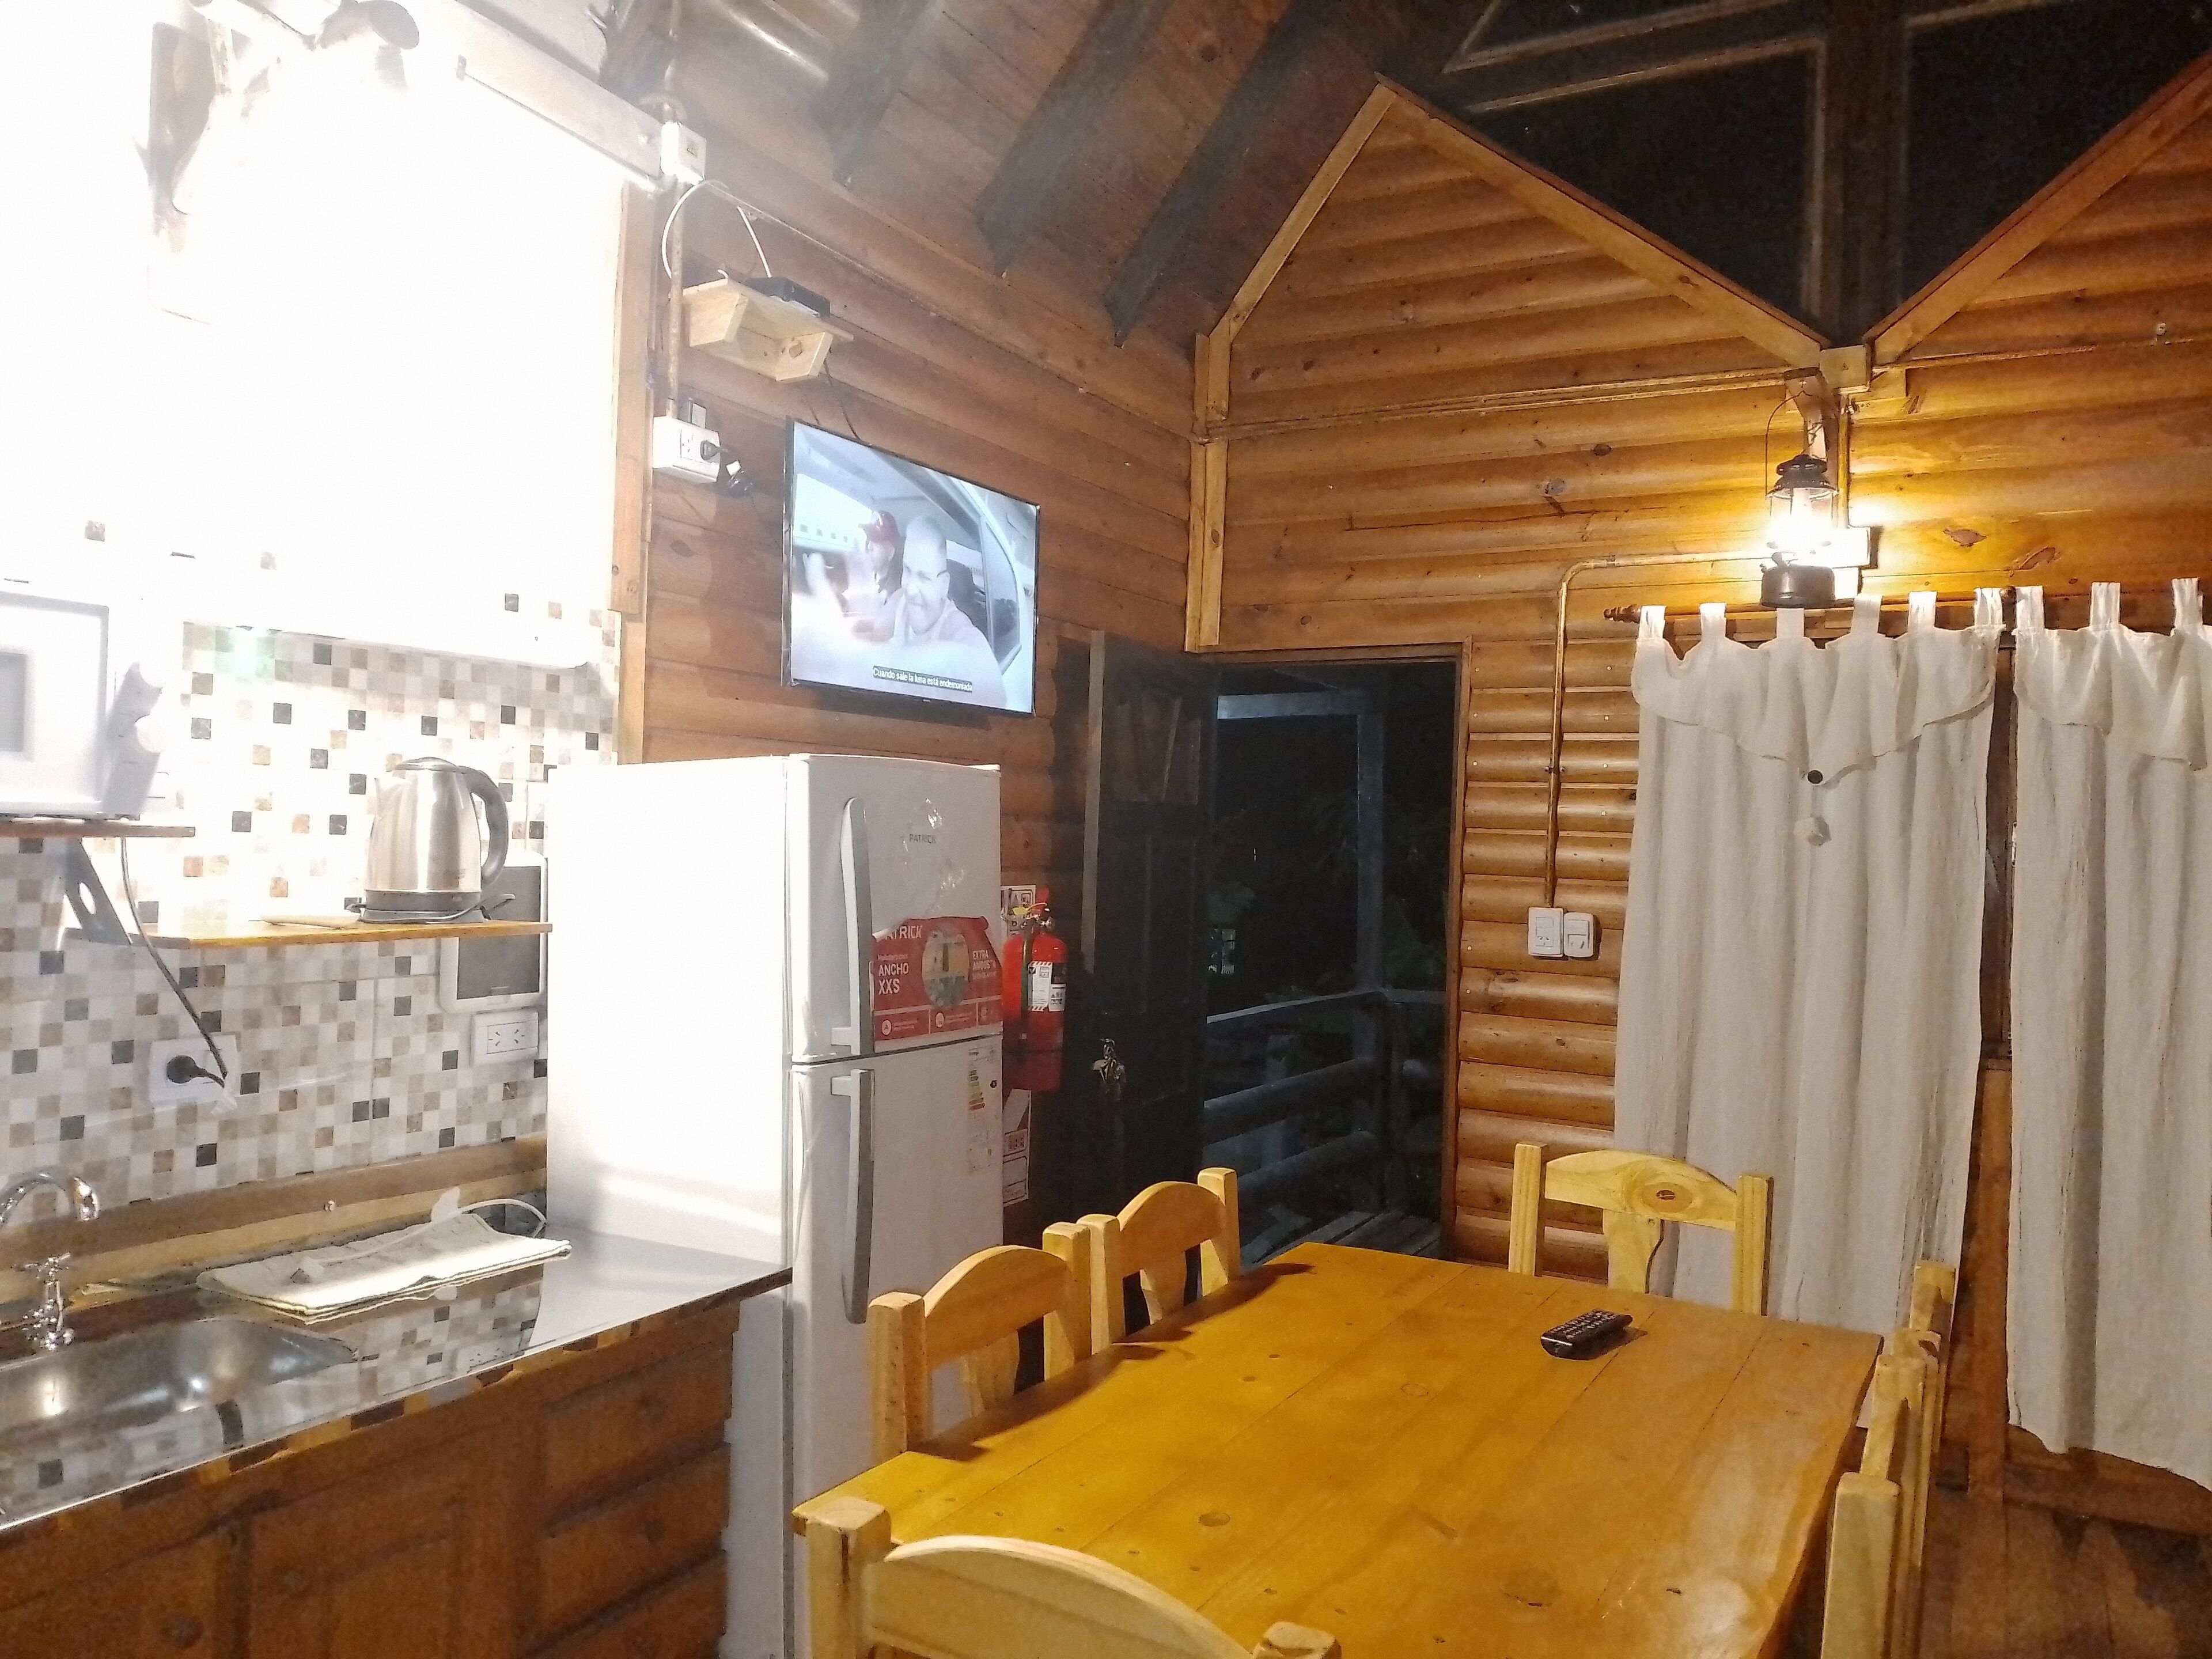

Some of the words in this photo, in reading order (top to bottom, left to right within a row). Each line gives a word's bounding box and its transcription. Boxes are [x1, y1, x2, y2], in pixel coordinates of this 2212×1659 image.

[873, 668, 895, 679] Cuando
[896, 672, 907, 681] sale
[908, 673, 914, 682] la
[915, 673, 926, 684] luna
[927, 677, 939, 686] está
[939, 680, 972, 691] endemoniada
[910, 834, 936, 844] PATRICK
[878, 963, 909, 976] ANCHO
[878, 978, 900, 995] XXS
